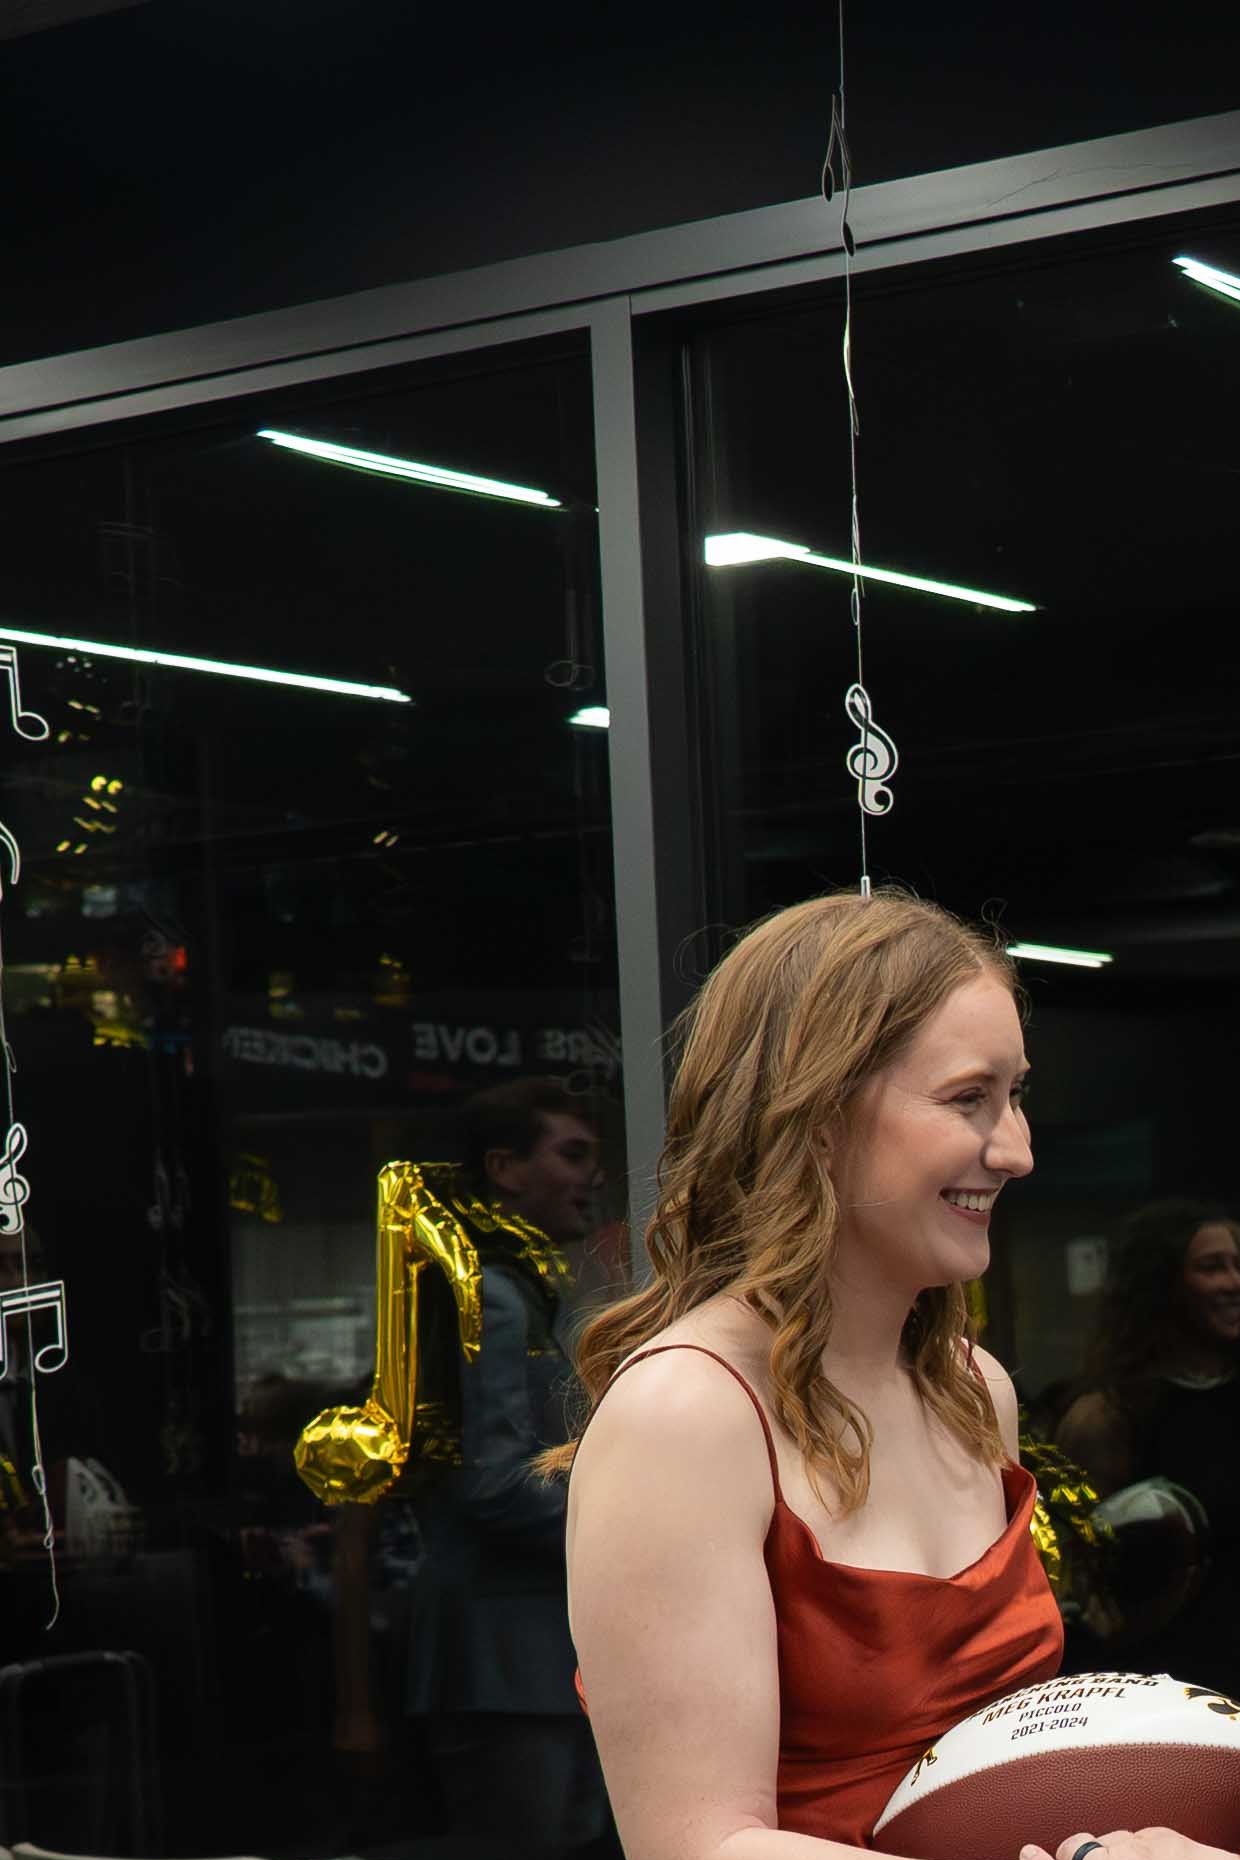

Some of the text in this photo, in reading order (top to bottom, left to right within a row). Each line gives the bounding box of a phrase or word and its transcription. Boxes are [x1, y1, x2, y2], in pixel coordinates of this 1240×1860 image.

[982, 1687, 1128, 1726] MEG KRAPFL
[1018, 1702, 1082, 1723] PICCOLO
[1010, 1716, 1089, 1741] 2021-2024
